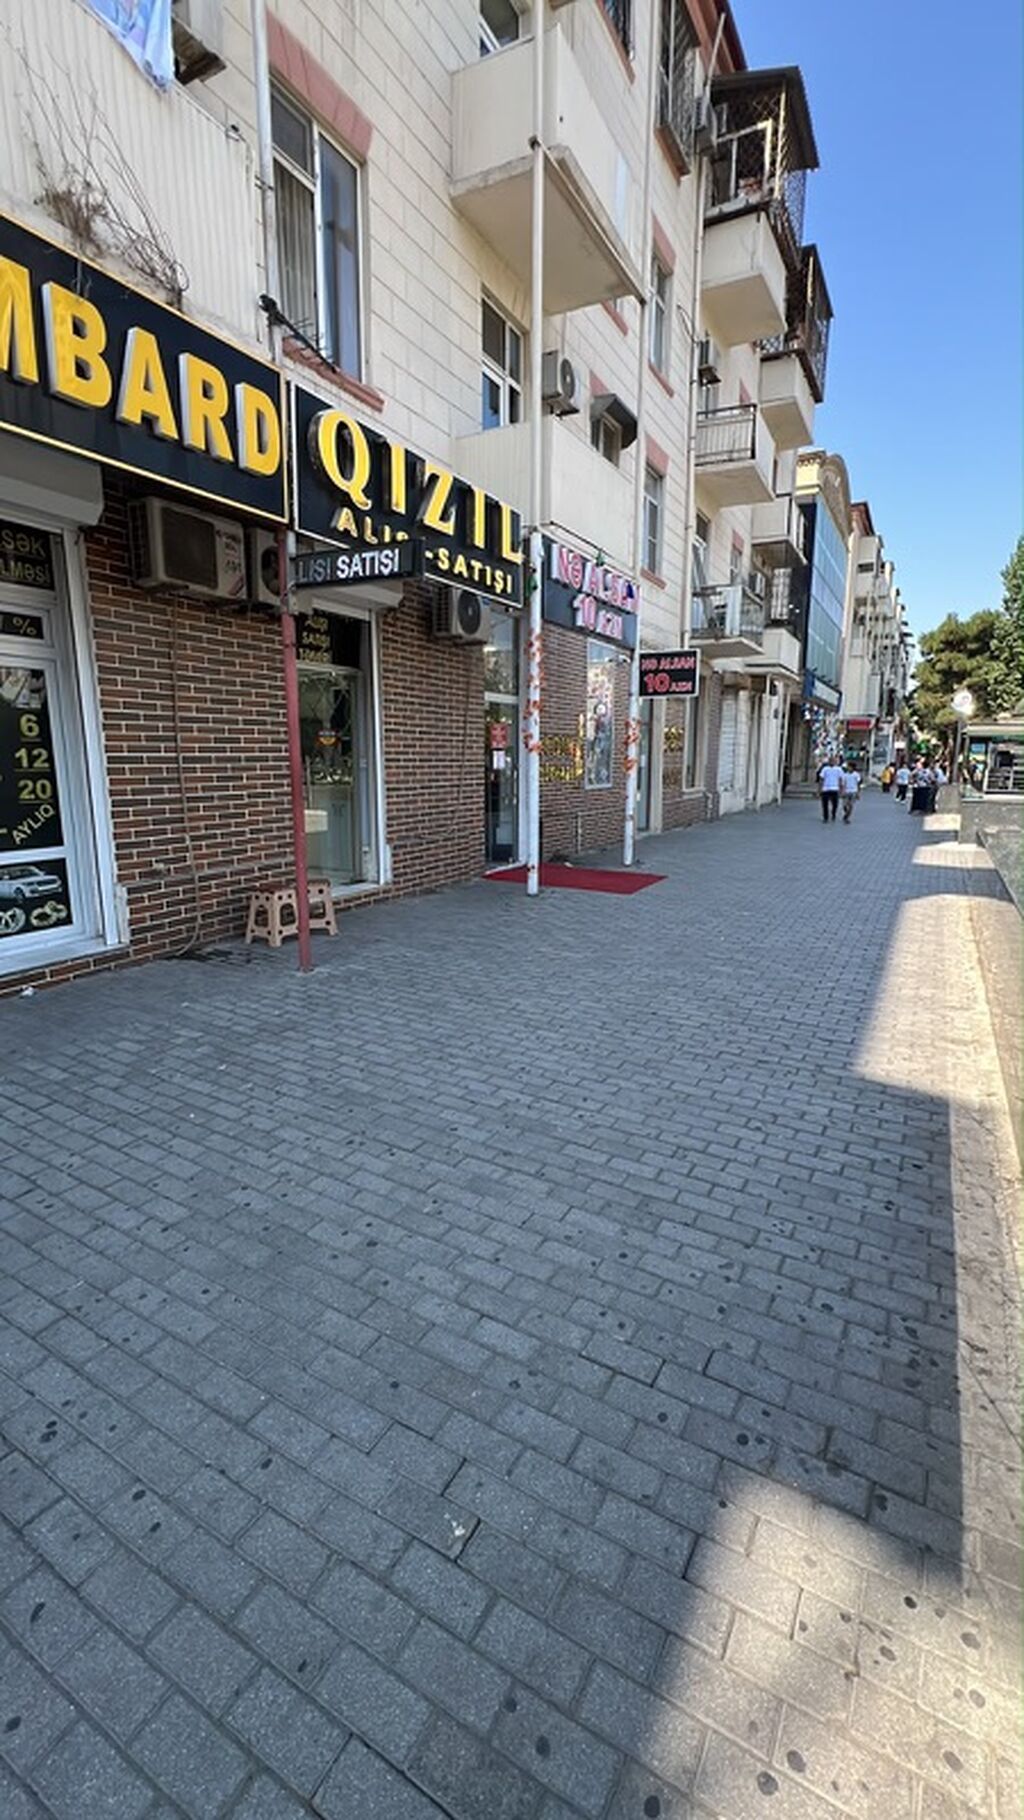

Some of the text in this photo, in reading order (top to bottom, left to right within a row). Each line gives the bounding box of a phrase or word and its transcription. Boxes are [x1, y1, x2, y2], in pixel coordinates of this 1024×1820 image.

[309, 409, 523, 564] QIZIL
[573, 594, 596, 630] 10
[644, 672, 670, 692] 10
[20, 713, 40, 737] 6
[15, 747, 49, 768] 12
[18, 779, 51, 799] 20
